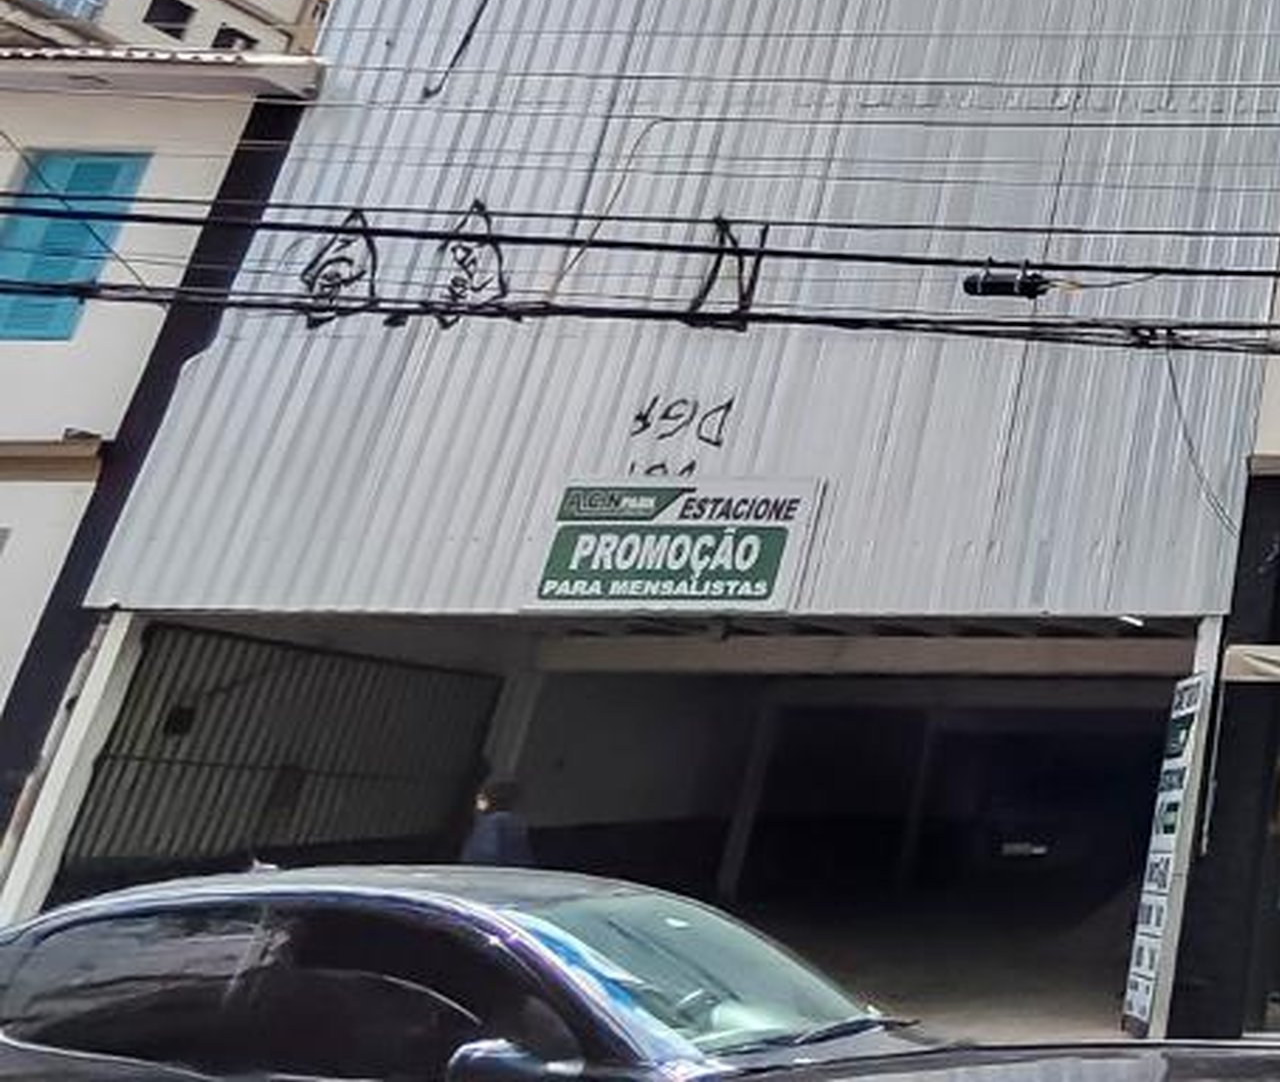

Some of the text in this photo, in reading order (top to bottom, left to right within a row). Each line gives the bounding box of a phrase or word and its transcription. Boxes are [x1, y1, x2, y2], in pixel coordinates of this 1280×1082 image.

[678, 497, 800, 521] ESTACIONE
[569, 527, 761, 582] PROMOÇÃO
[541, 580, 768, 597] PARA MENSALISTAS
